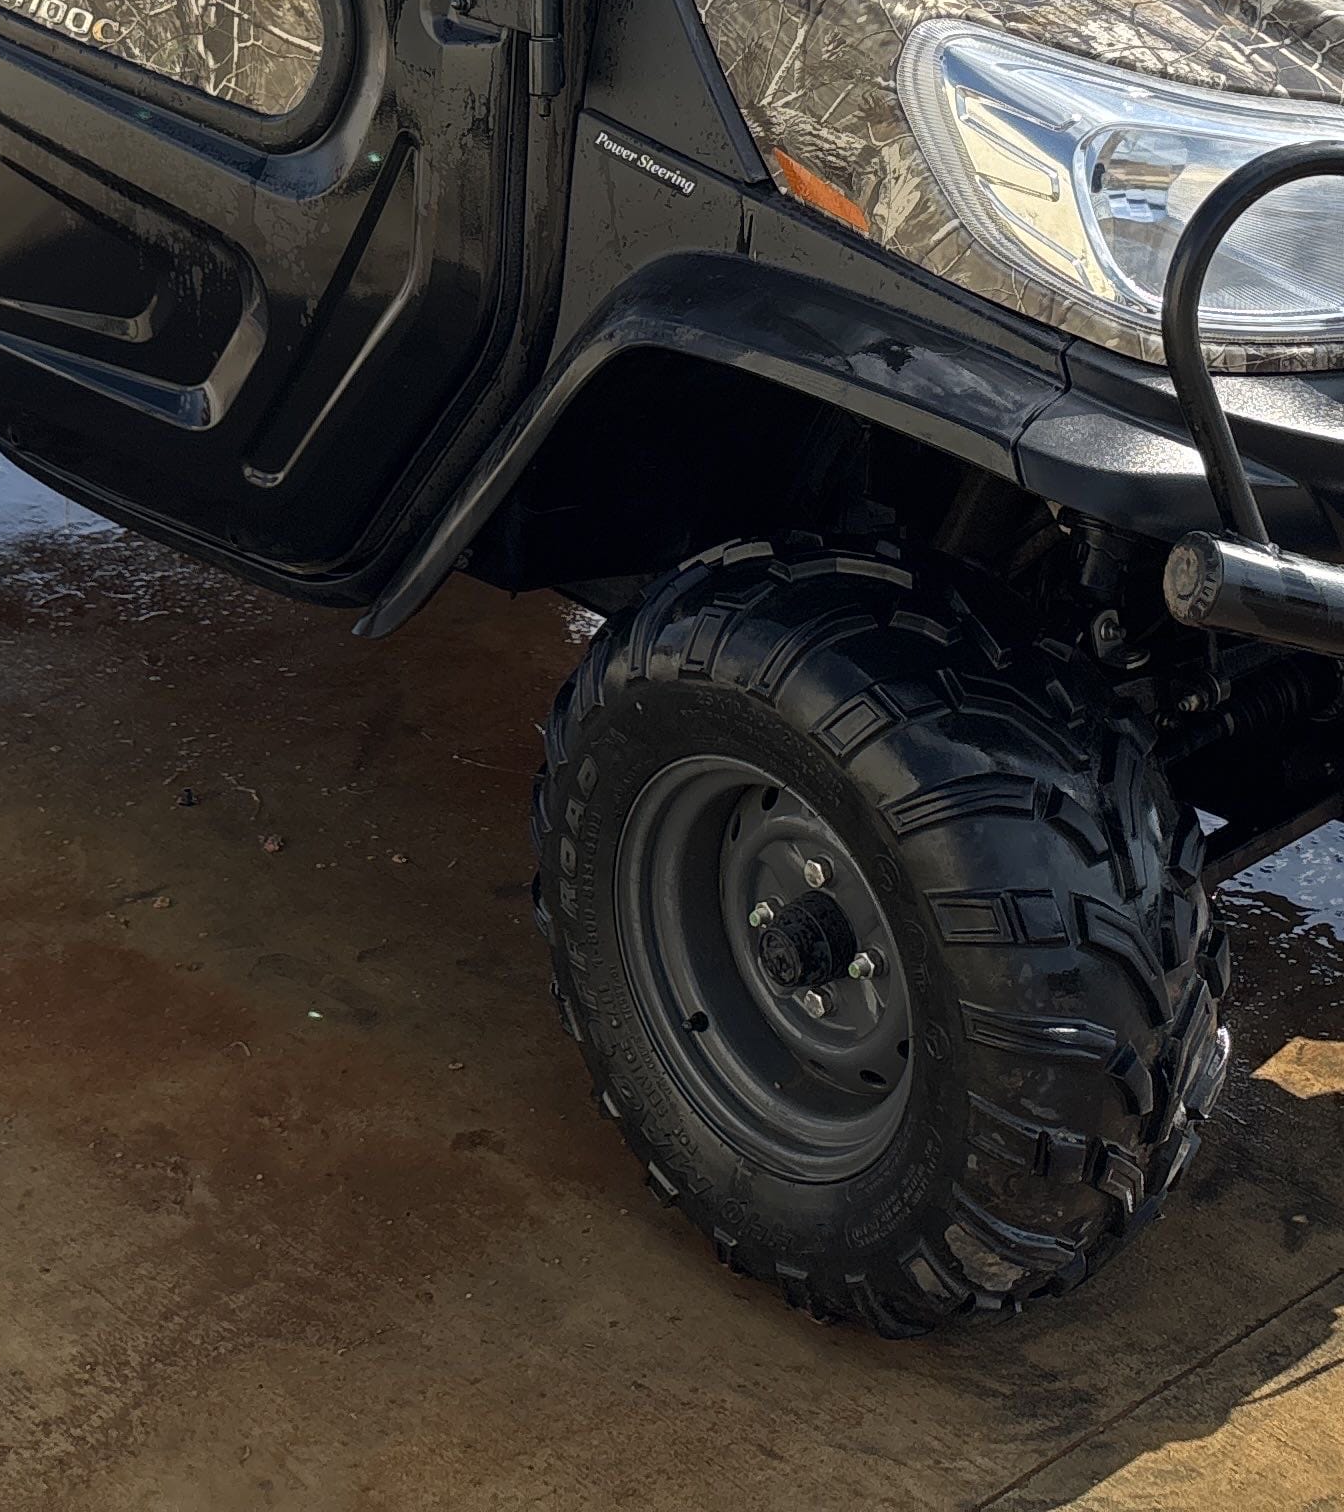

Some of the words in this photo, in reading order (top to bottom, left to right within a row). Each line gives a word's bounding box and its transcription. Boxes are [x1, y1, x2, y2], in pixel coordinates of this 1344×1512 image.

[595, 131, 638, 163] Power
[637, 153, 696, 194] Steering
[558, 752, 600, 914] ROAD
